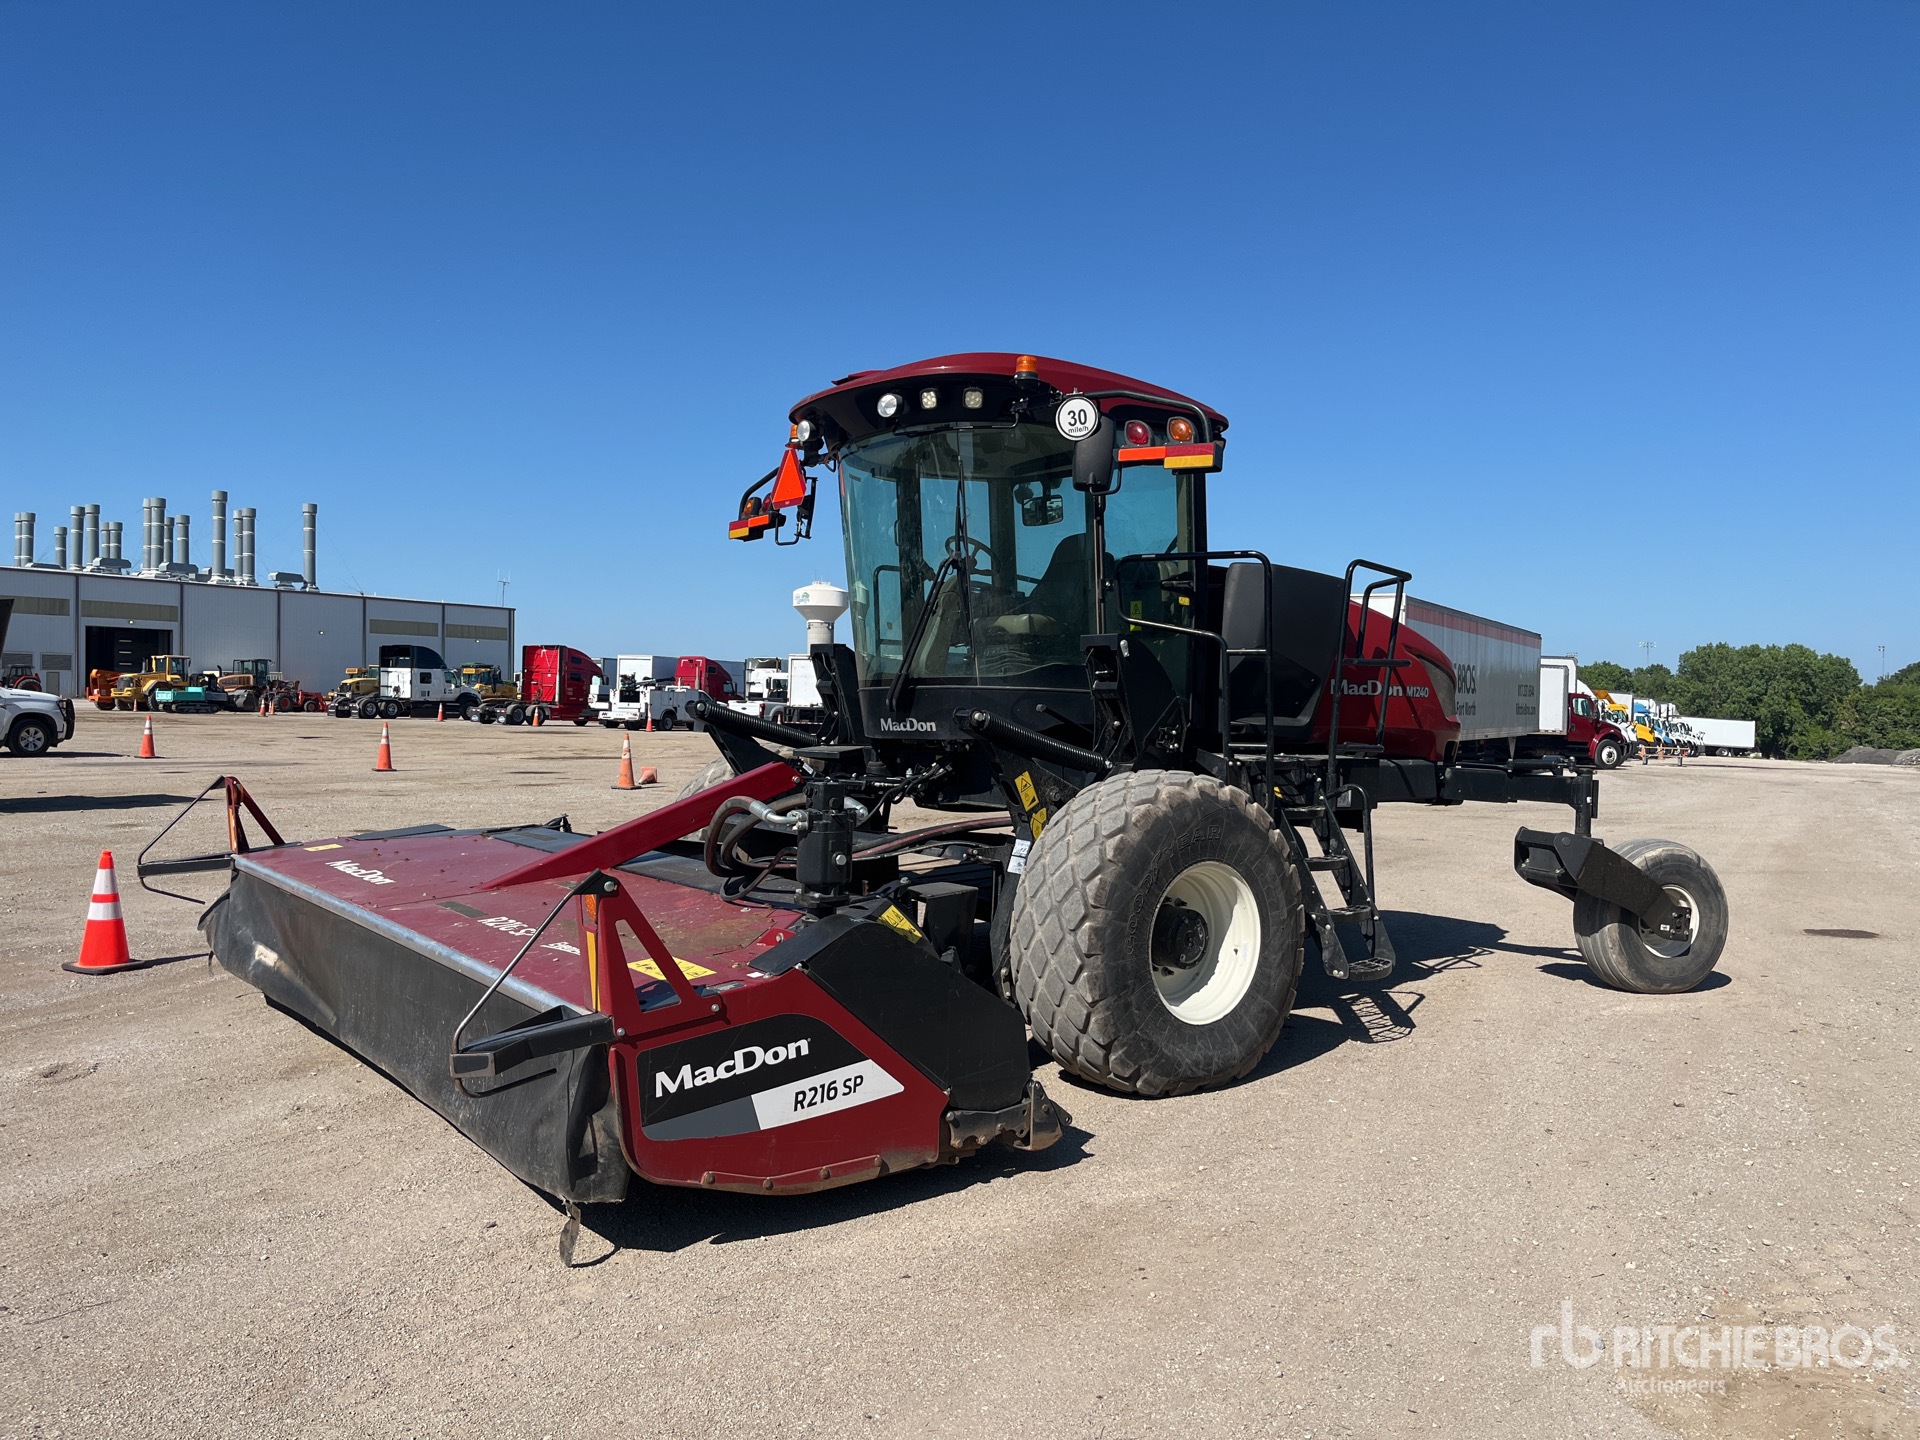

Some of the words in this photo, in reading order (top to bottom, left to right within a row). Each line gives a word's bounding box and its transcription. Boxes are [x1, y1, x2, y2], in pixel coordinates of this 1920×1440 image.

[1067, 408, 1088, 426] 30
[1068, 426, 1089, 434] mile/h
[1405, 686, 1430, 698] M1240
[880, 717, 937, 731] MacDon
[324, 859, 396, 885] MacDon
[654, 1037, 810, 1098] MacDon
[793, 1079, 839, 1113] R216
[841, 1073, 865, 1097] SP
